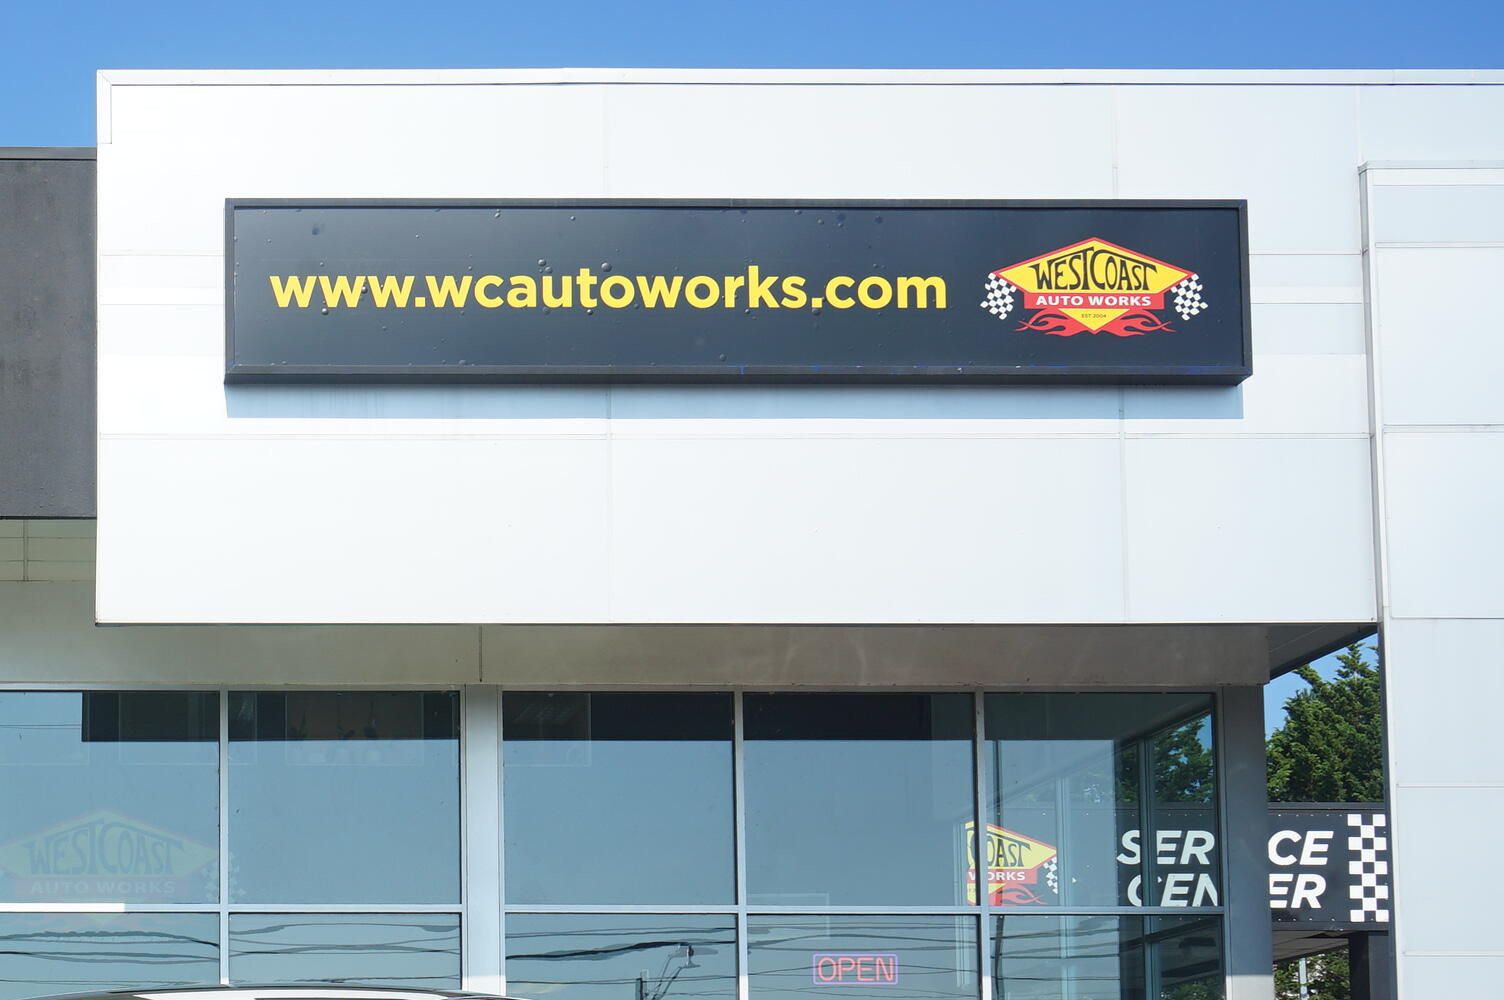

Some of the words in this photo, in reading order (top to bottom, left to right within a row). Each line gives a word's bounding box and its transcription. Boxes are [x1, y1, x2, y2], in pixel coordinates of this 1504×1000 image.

[269, 265, 947, 309] www.wcautoworks.com
[1036, 295, 1084, 306] AUTO
[1088, 295, 1152, 306] WORKS
[1116, 830, 1334, 866] SERCE
[30, 881, 88, 895] AUTO
[96, 881, 176, 895] WORKS
[1127, 873, 1327, 908] CENER
[817, 957, 894, 981] OPEN
